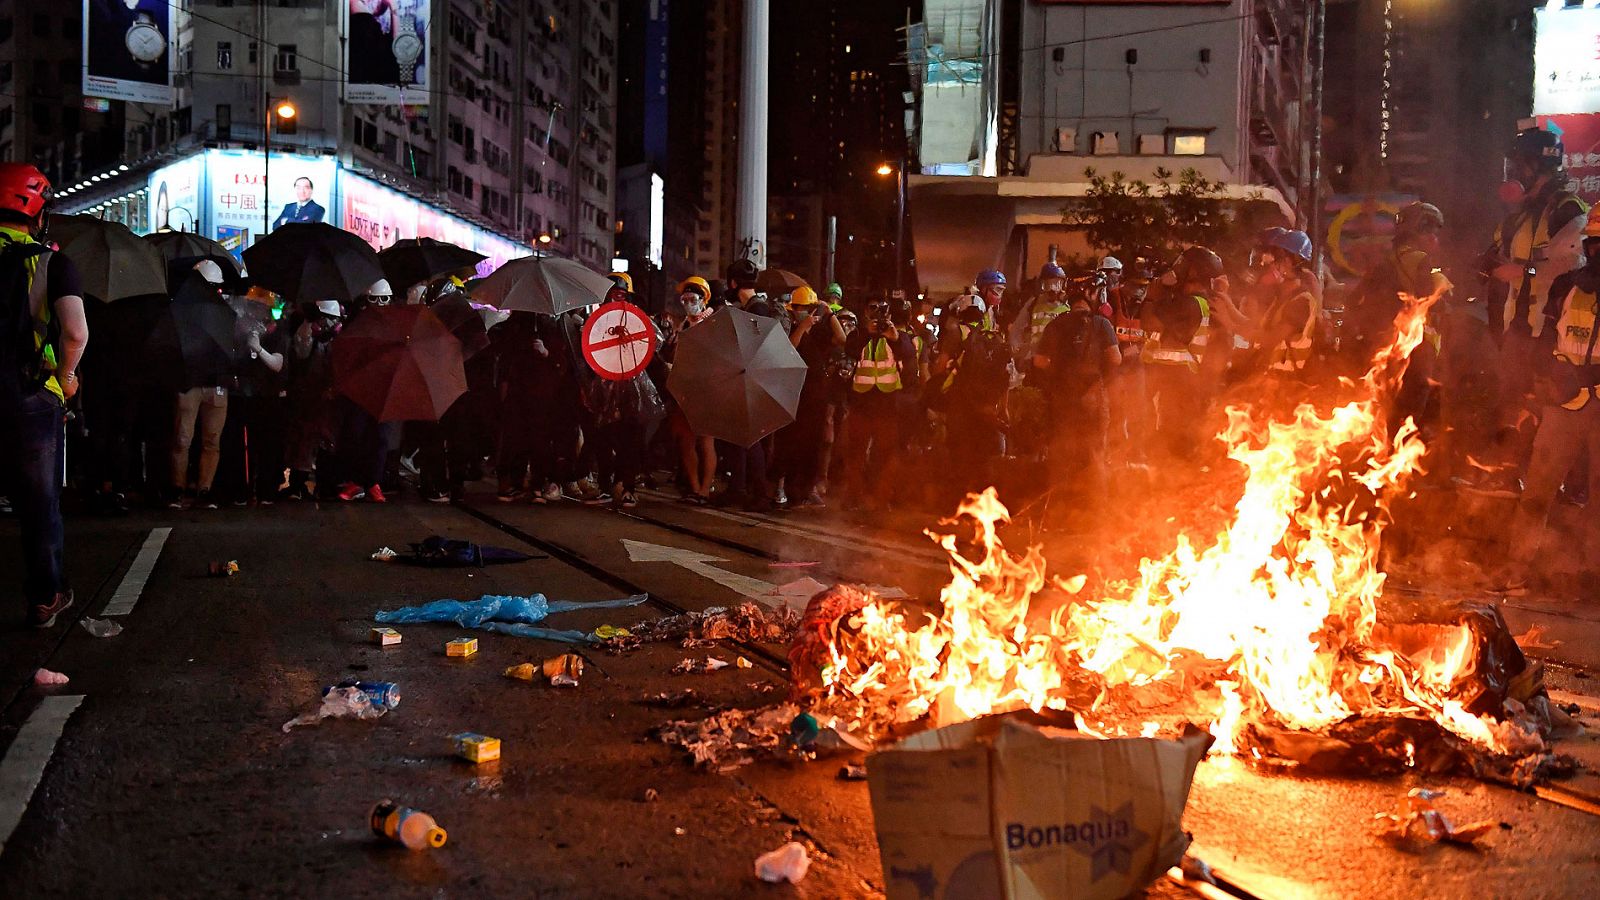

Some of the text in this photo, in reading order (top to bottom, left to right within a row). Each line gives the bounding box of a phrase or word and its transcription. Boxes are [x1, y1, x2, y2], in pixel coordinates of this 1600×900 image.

[220, 192, 258, 210] 中風
[350, 214, 380, 239] LOVE ME
[1006, 818, 1129, 850] Bonaqua
